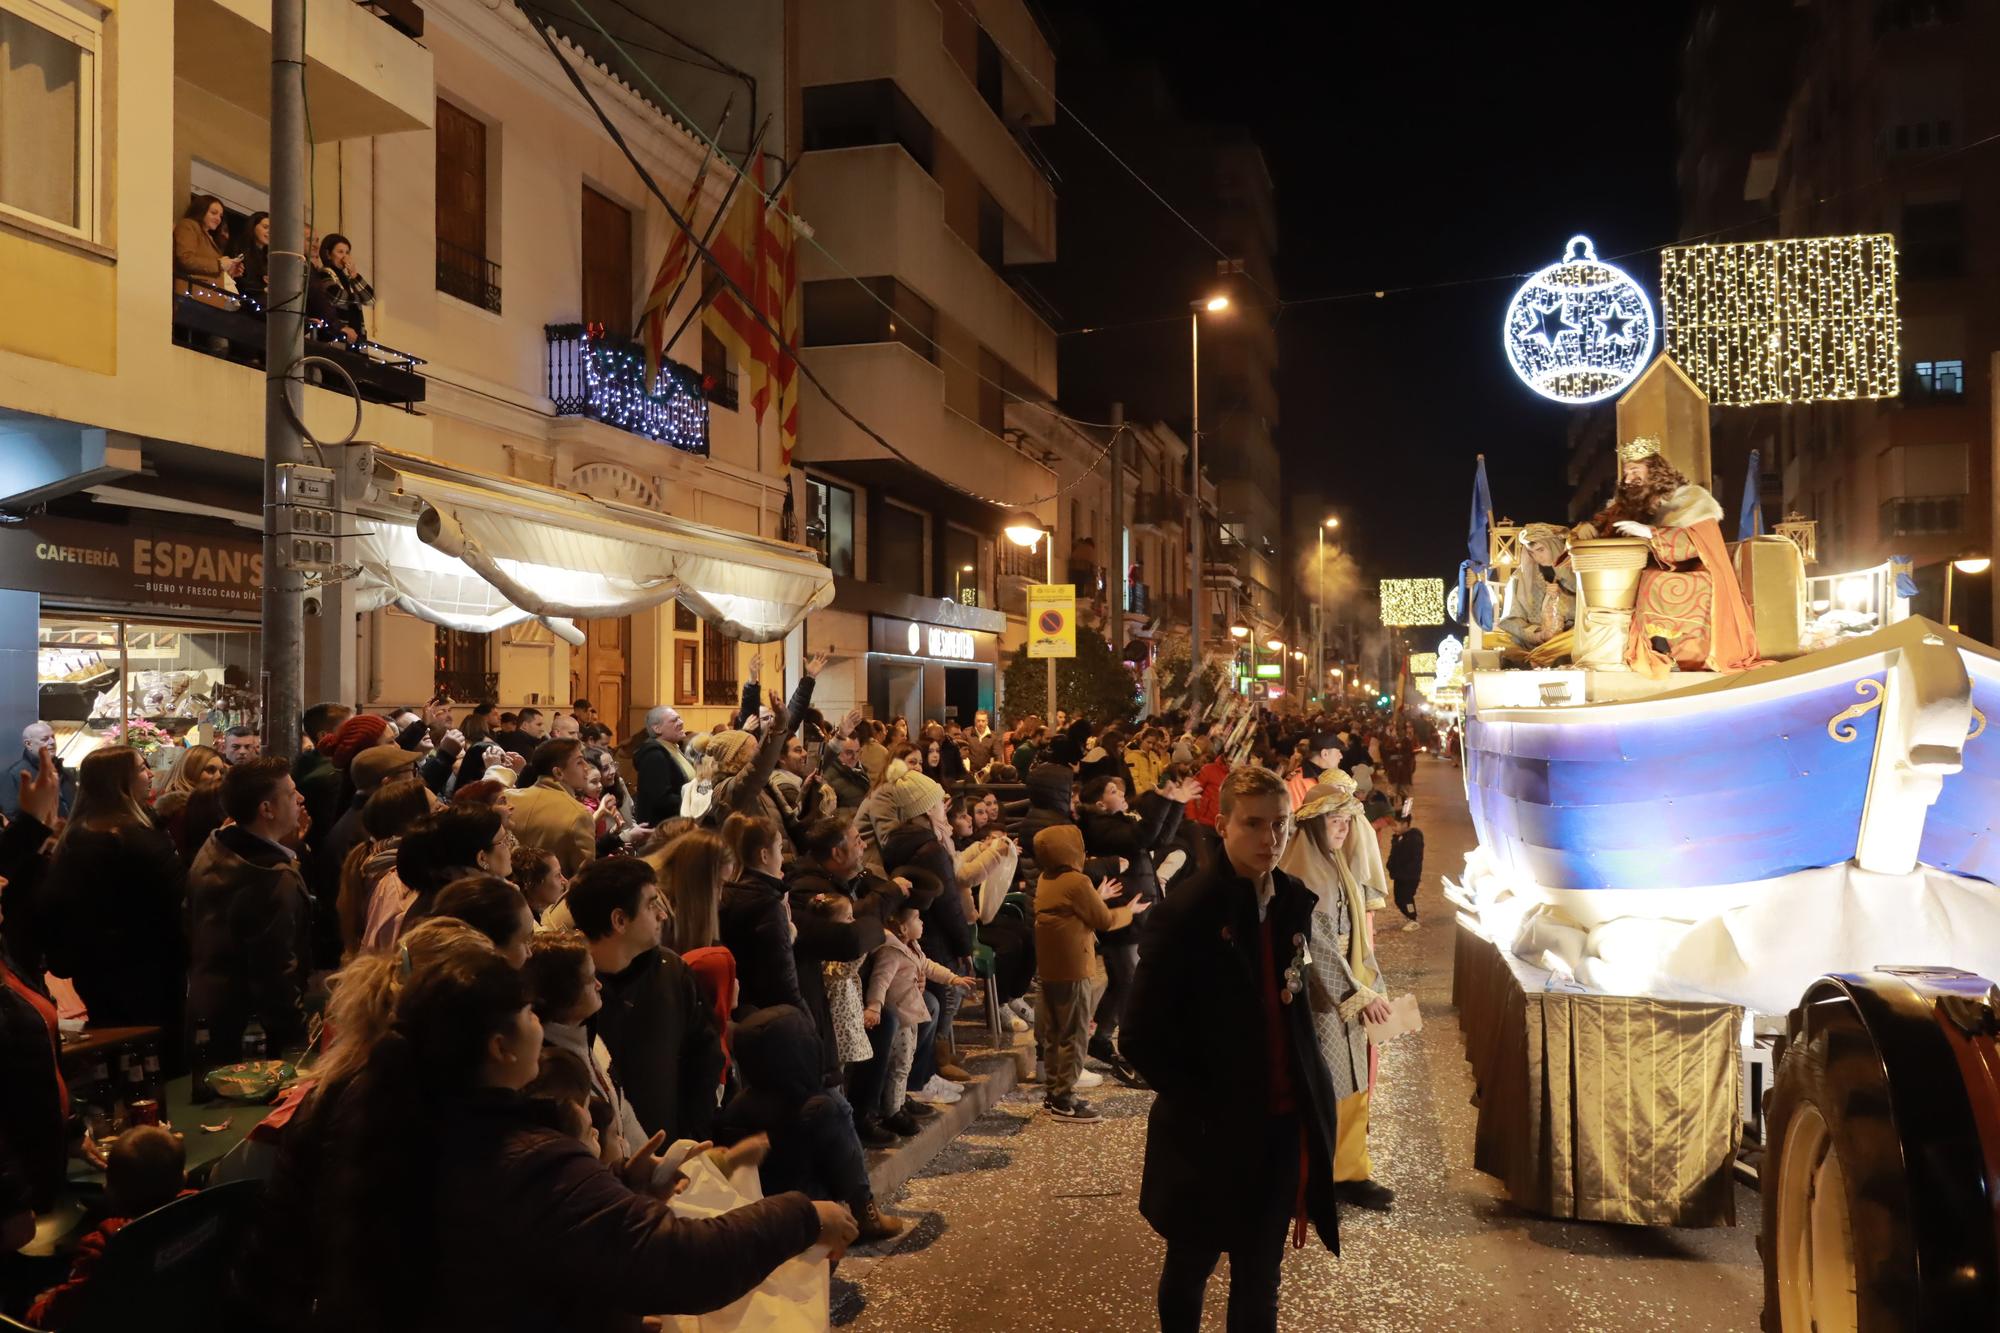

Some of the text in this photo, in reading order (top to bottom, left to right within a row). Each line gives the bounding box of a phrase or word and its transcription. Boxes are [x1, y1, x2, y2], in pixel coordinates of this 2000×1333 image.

[35, 543, 120, 568] CAFETERÍA
[133, 538, 264, 587] ESPAN'S
[146, 582, 256, 600] BUENO Y FRESCO CADA DÍA
